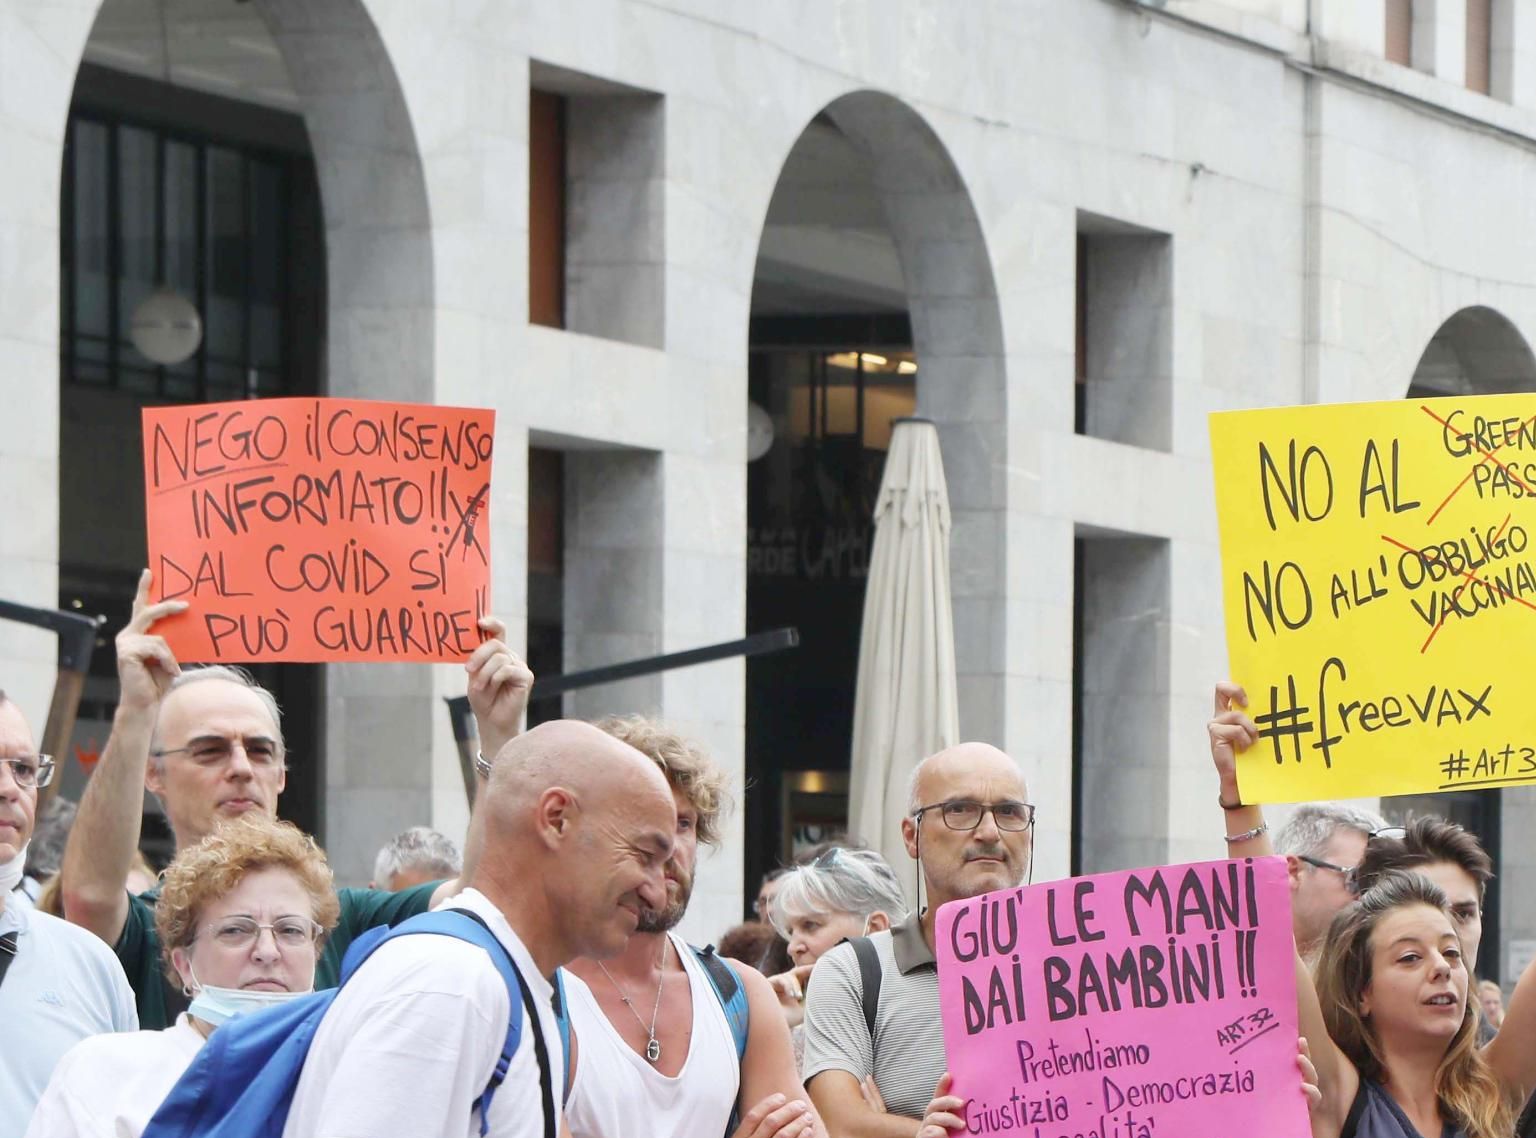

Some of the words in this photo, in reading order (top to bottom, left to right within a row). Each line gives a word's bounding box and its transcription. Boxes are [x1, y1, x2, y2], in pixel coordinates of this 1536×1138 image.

[152, 411, 288, 487] NEGO
[327, 409, 492, 471] CONSENSO
[1259, 438, 1334, 531] NO
[1359, 438, 1420, 518] AL
[191, 466, 452, 539] INFORMATO!!
[158, 551, 253, 602] DAL
[265, 538, 390, 596] COVID
[1243, 559, 1313, 642] NO
[204, 608, 290, 658] PUÒ
[1047, 881, 1105, 947] LE
[1123, 858, 1259, 936] MANI
[962, 953, 1026, 1035] DAI
[1016, 1027, 1151, 1085] Pretendiamo
[964, 1091, 1070, 1136] Giustizia
[1102, 1060, 1255, 1114] Democrazia
